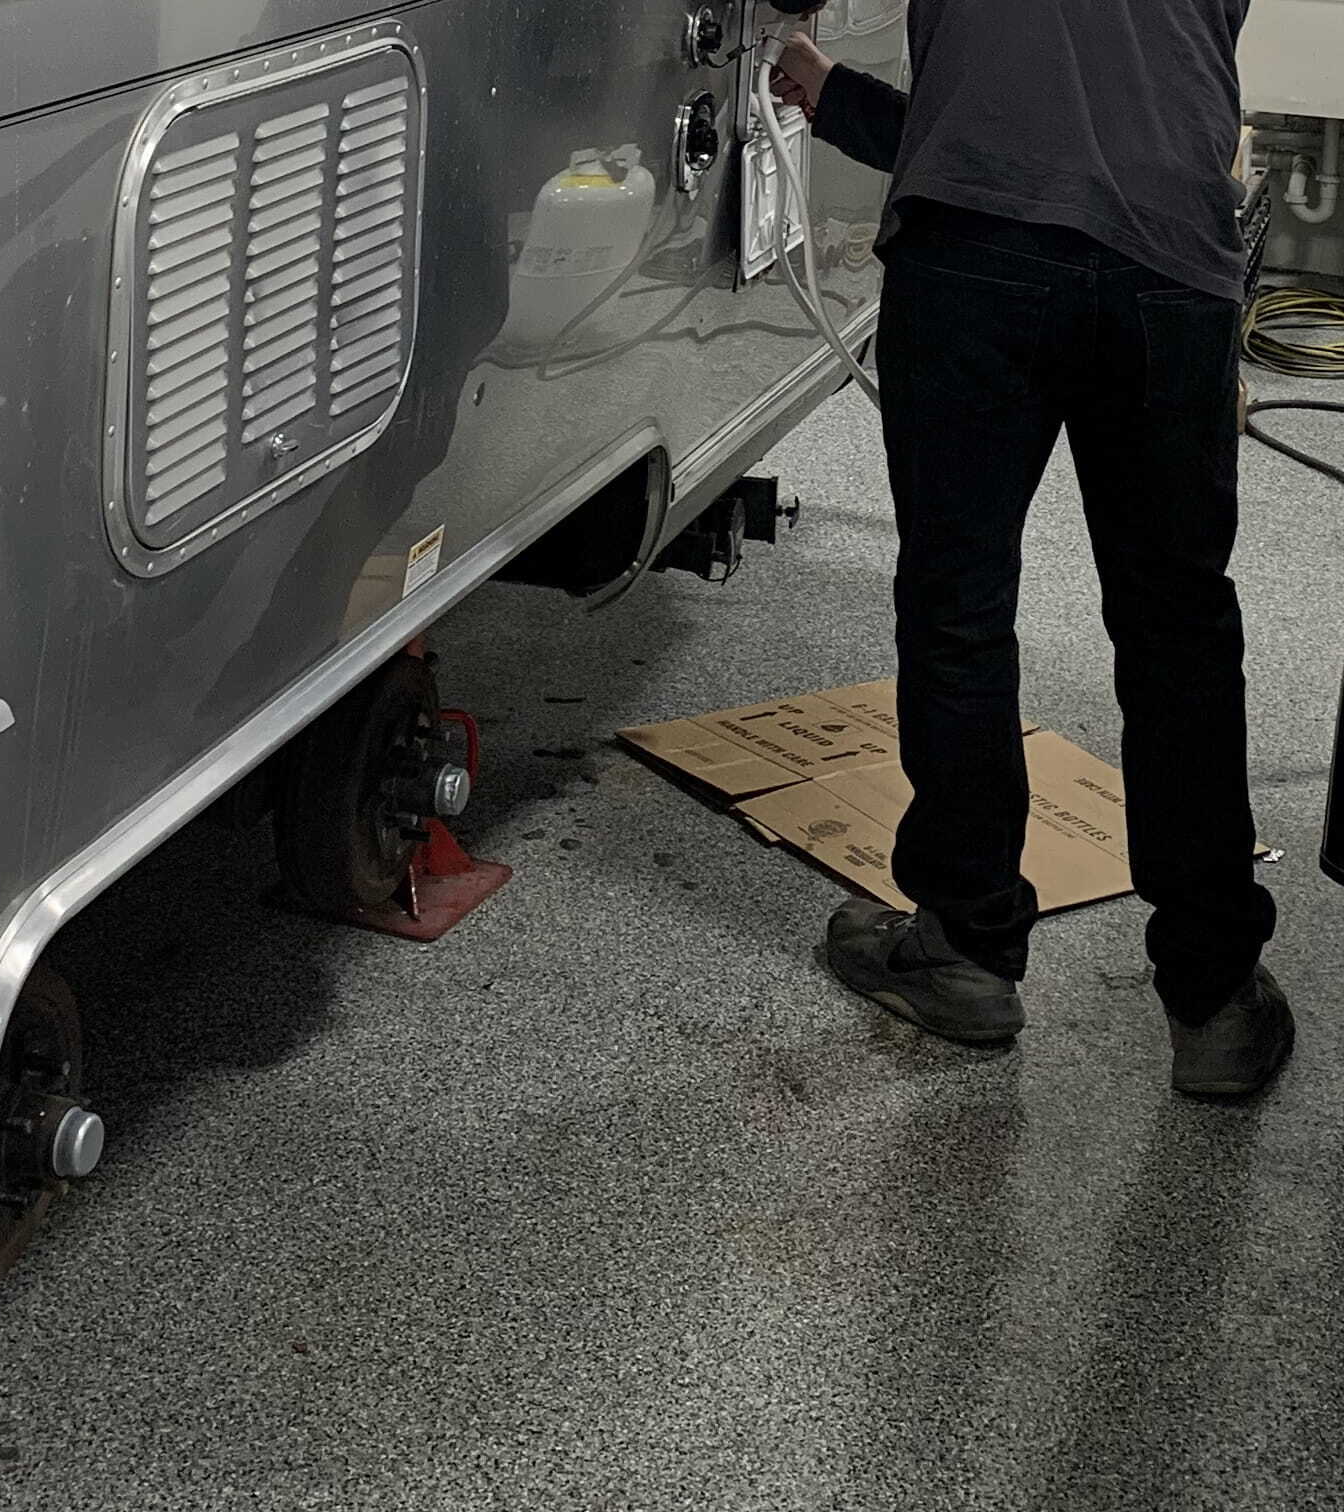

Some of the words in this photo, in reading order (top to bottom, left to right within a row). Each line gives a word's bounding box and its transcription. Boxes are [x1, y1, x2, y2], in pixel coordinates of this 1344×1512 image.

[778, 704, 804, 714] UP
[717, 720, 759, 740] HANDLE
[755, 739, 787, 753] WITH
[781, 752, 815, 767] CARE
[777, 721, 834, 746] LIQUID
[859, 743, 888, 754] UP
[1054, 811, 1112, 841] BOTTLES
